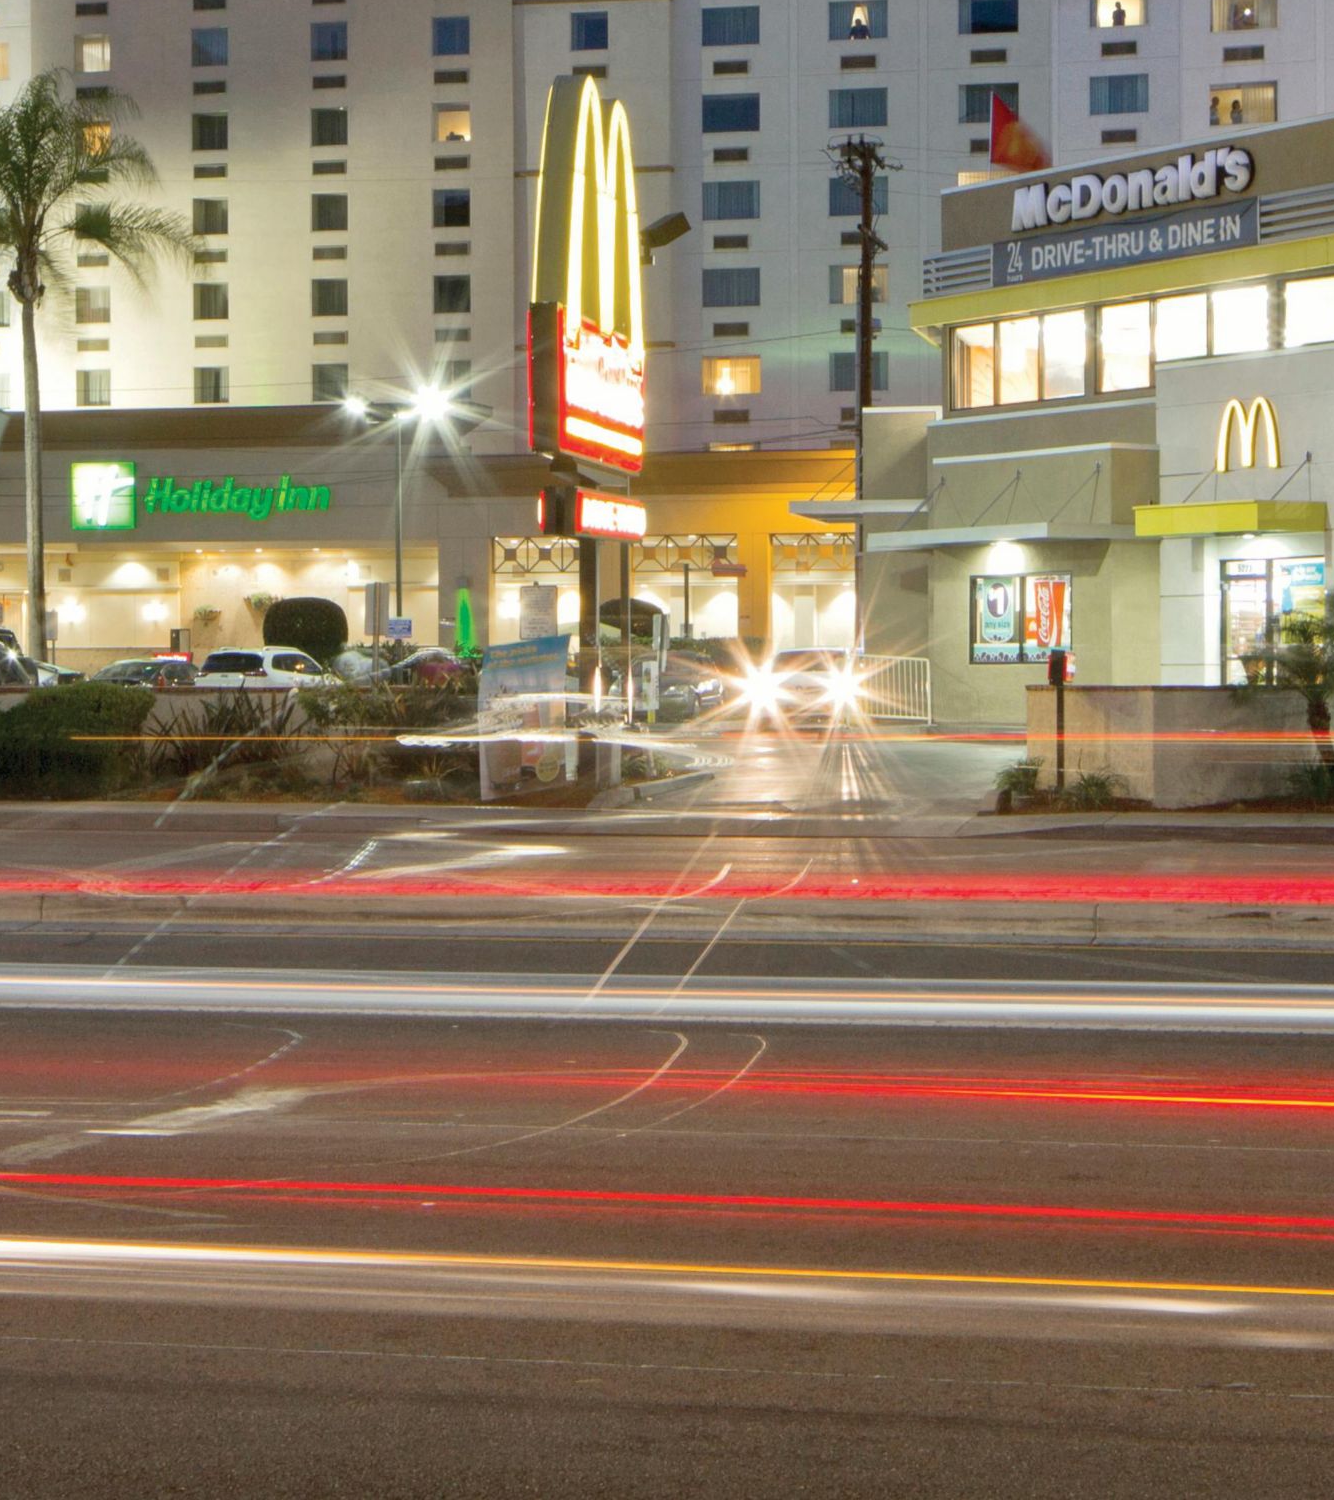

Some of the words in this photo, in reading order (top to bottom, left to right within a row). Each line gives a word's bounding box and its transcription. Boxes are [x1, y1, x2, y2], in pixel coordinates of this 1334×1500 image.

[1010, 145, 1253, 233] McDonald's
[1006, 241, 1023, 274] 24
[1031, 230, 1145, 271] DRIVE-THRU
[1148, 227, 1163, 252] &
[1168, 217, 1216, 251] DINE
[1219, 214, 1241, 242] IN
[144, 475, 274, 521] Holiday
[275, 472, 331, 512] Inn
